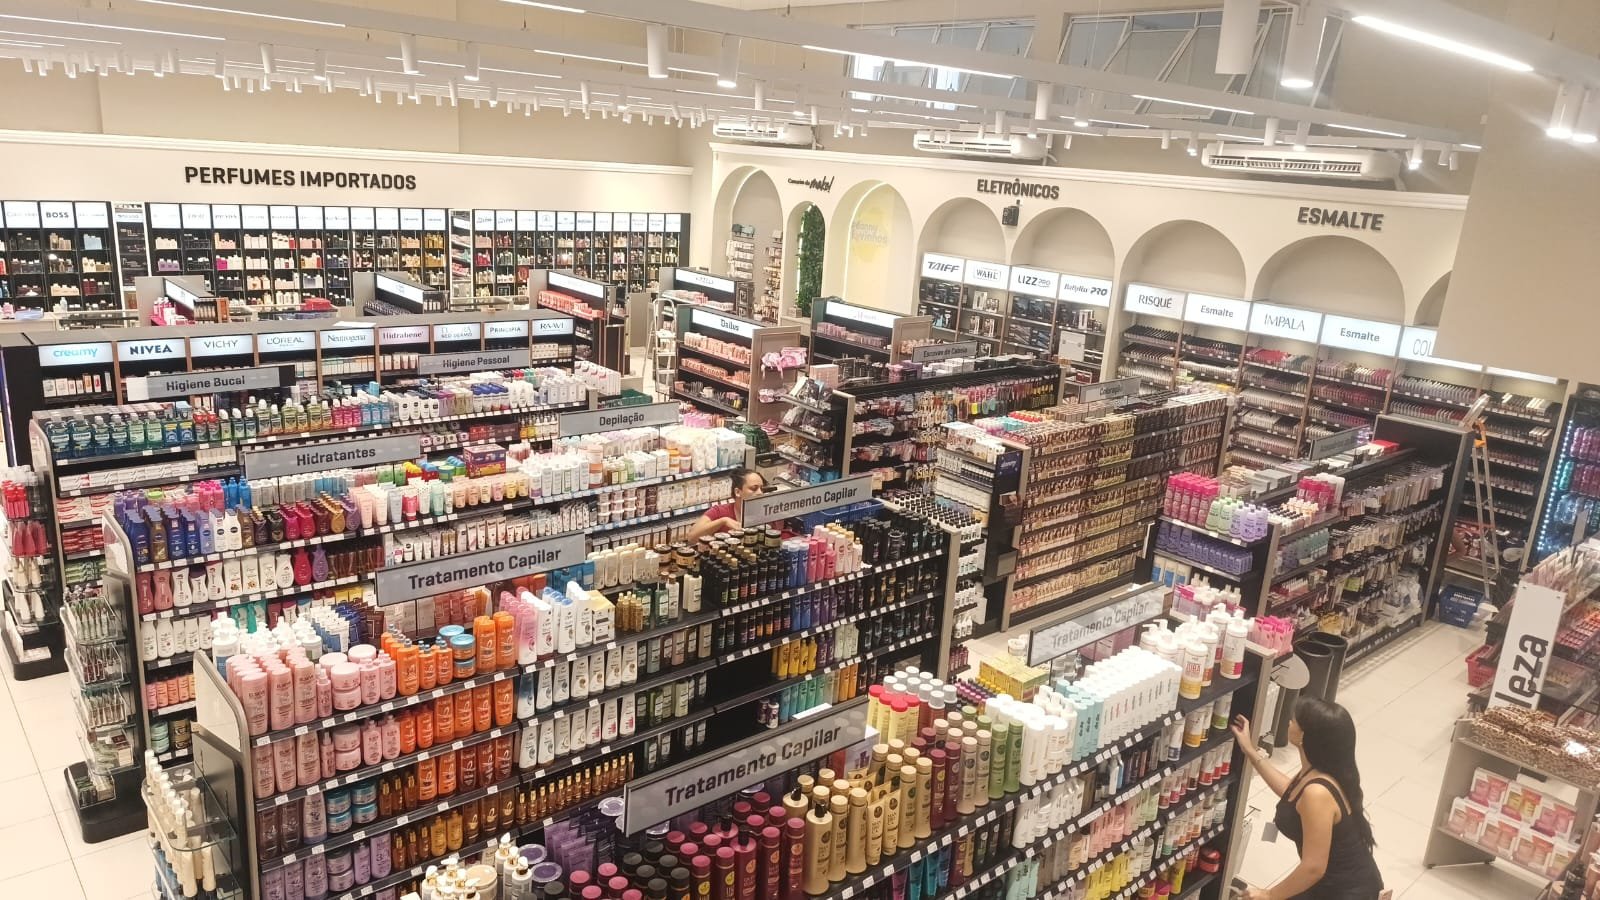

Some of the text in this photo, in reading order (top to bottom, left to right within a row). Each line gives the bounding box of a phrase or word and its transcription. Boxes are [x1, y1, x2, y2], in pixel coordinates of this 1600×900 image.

[184, 166, 417, 191] PERFUMES IMPORTADOS
[976, 178, 1060, 200] ELETRÔNICOS
[1297, 206, 1385, 231] ESMALTE
[1017, 274, 1038, 286] LIZZ
[1138, 293, 1172, 309] RISQUÉ
[1200, 304, 1234, 318] Esmalte
[1264, 313, 1306, 332] IMPALA
[203, 339, 239, 349] VICHY
[1340, 327, 1380, 343] Esmalte
[53, 346, 98, 358] creamy
[129, 343, 173, 355] NIVEA
[442, 354, 510, 369] Higiene Pessoal
[166, 375, 245, 393] Higiene Bucal
[599, 412, 645, 427] Depilação
[296, 448, 376, 466] Hidratantes
[763, 487, 858, 516] Tratamento Capilar
[408, 548, 562, 590] Tratamento Capilar
[1051, 601, 1149, 648] Tratamento Capilar
[665, 726, 842, 807] Tratamento Capilar
